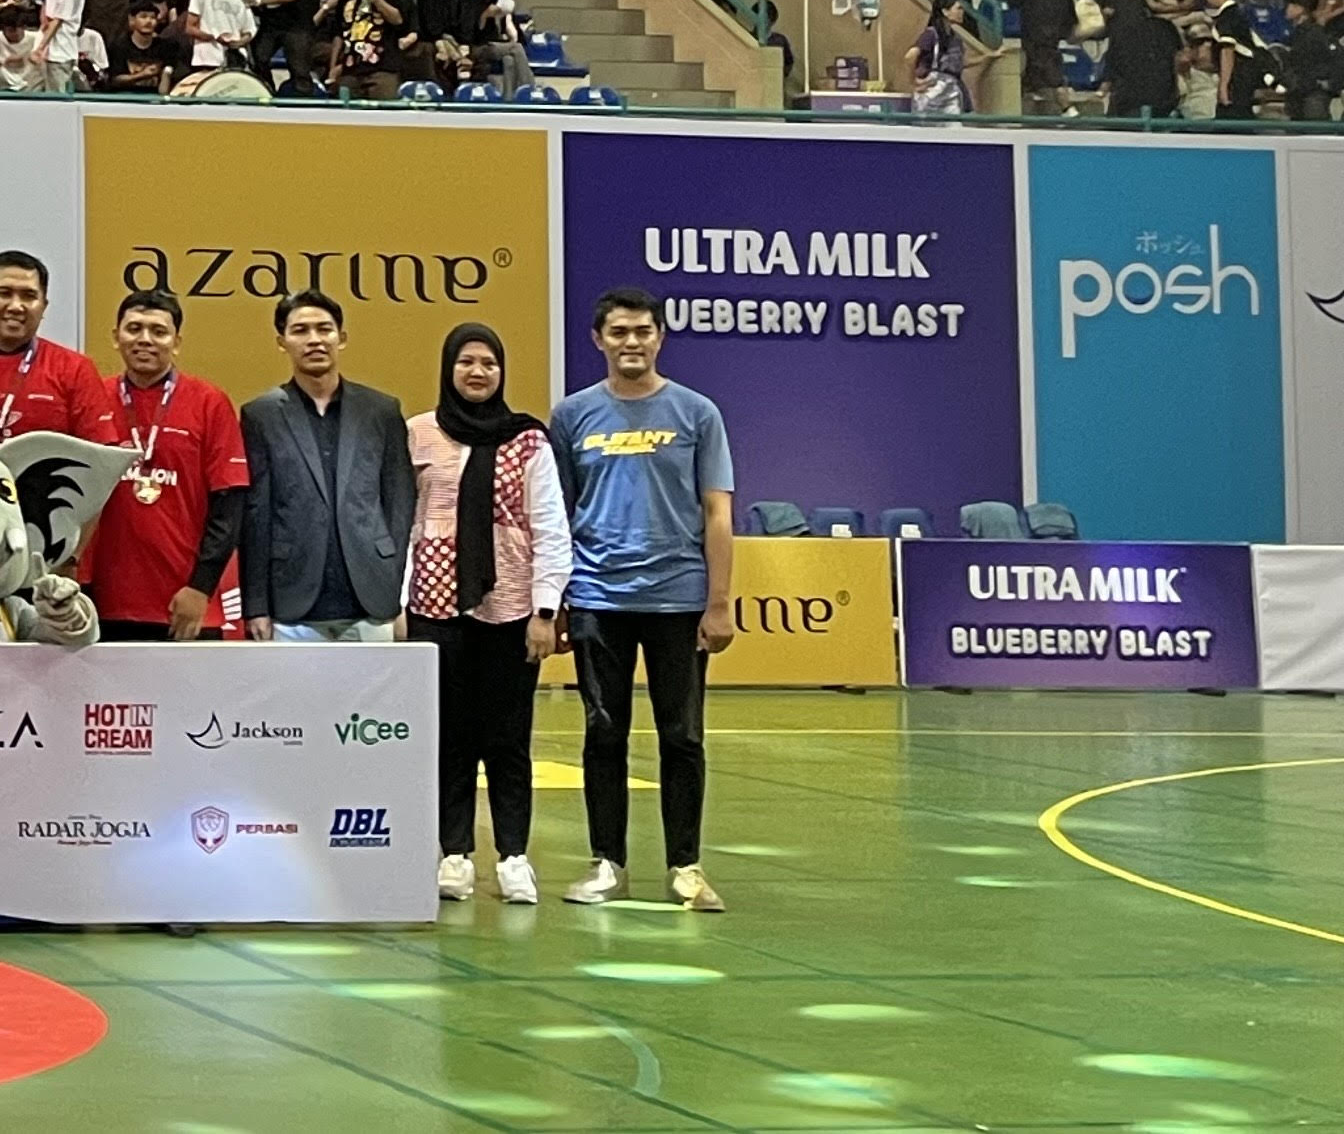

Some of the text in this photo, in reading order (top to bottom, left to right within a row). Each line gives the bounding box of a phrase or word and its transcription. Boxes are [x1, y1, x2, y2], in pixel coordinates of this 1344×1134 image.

[644, 226, 930, 279] ULTRA MILK
[123, 246, 489, 303] azarine
[1059, 224, 1261, 359] posh
[665, 297, 965, 339] UEBERRY BLAST
[968, 565, 1182, 604] ULTRA MILK
[951, 626, 1213, 659] BLUEBERRY BLAST
[85, 729, 153, 750] CREAM
[232, 721, 304, 739] Jackson
[18, 820, 152, 839] RADAR JOGJA
[235, 823, 299, 835] PERBASI
[330, 809, 391, 836] DBL
